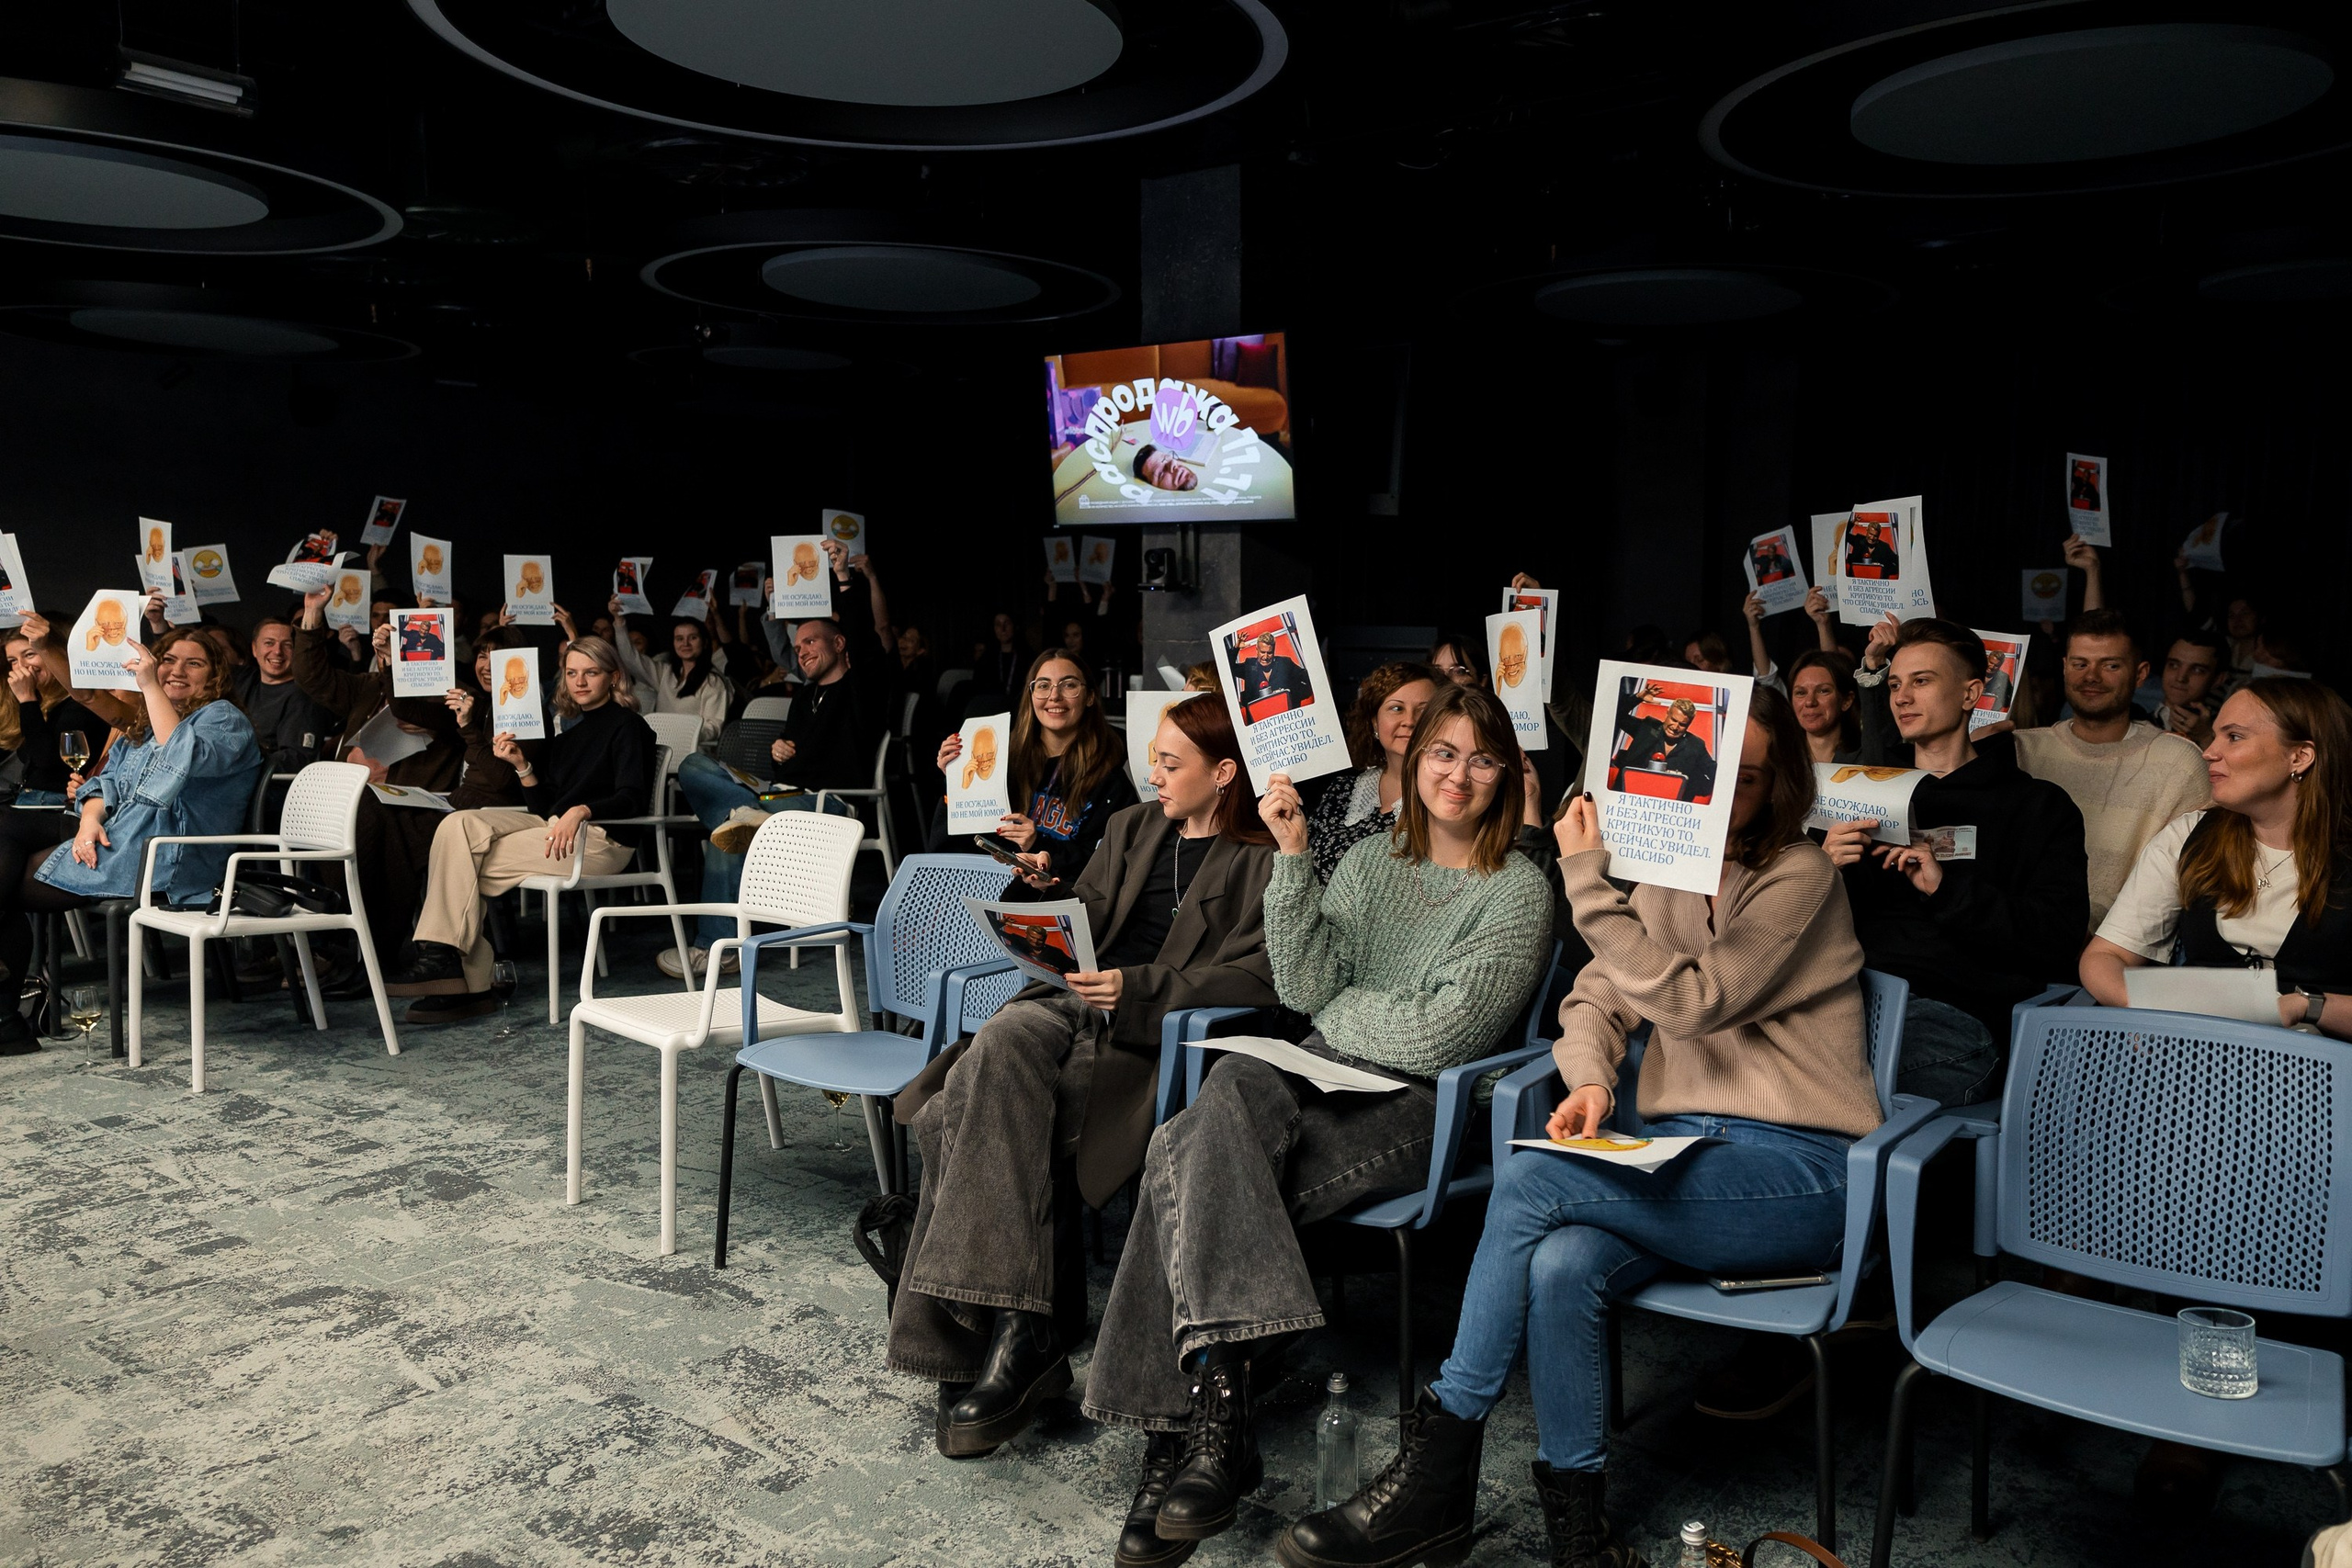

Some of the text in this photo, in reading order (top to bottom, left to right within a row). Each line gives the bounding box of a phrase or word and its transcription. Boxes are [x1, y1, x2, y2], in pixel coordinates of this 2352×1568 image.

[1858, 579, 1890, 587] ТАКТИЧНО
[1864, 586, 1895, 594] АГРЕССИИ
[1850, 592, 1883, 601] КРИТИКУЮ
[1854, 598, 1876, 608] СЕЙЧАС
[1860, 606, 1885, 615] СПАСИБО
[97, 668, 116, 676] МОЙ
[1250, 716, 1317, 746] И БЕЗ АГРЕССИИ
[1252, 708, 1304, 734] Я ТАКТИЧНО
[1250, 734, 1335, 768] ЧТО СЕЙЧАС УВИДЕЛ.
[1254, 732, 1299, 755] КРИТИКУЮ
[1269, 752, 1308, 772] СПАСИБО
[960, 810, 968, 818] НЕ
[968, 808, 983, 818] МОЙ
[983, 808, 1005, 818] ЮМОР
[1618, 794, 1692, 815] Я ТАКТИЧНО
[1828, 797, 1889, 818] ОСУЖДАЮ,
[1605, 805, 1702, 830] И БЕЗ АГРЕССИИ
[1819, 808, 1834, 819] НЕ
[1836, 811, 1860, 822] МОЙ
[1607, 818, 1675, 840] КРИТИКУЮ
[1678, 829, 1695, 843] ТО,
[1611, 831, 1658, 851] СЕЙЧАС
[1659, 840, 1711, 859] УВИДЕЛ.
[1618, 846, 1674, 865] СПАСИБО
